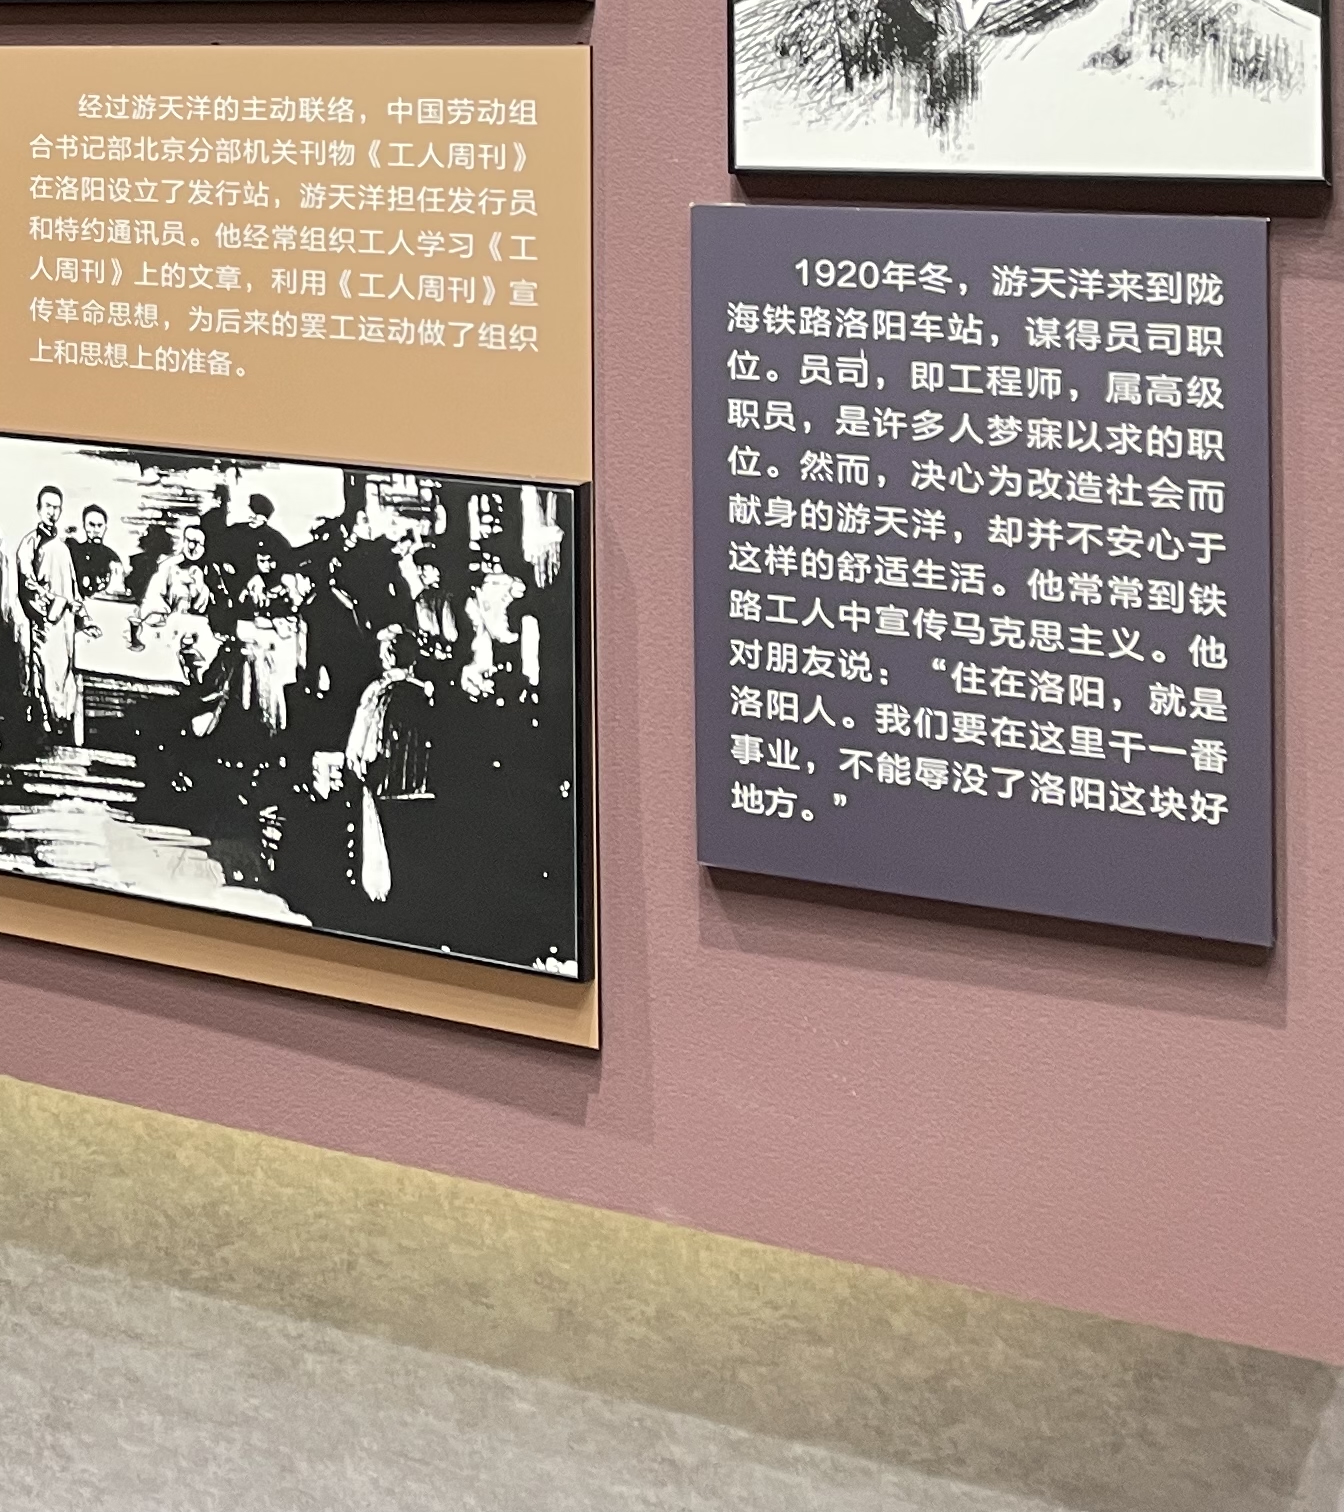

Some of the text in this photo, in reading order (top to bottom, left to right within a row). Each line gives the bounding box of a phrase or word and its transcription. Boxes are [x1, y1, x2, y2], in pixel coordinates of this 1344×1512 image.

[78, 94, 538, 126] 经过游天洋的主动联络，中国劳动组
[29, 134, 528, 172] 合书记部北京分部机关刊物《工人周刊》
[29, 175, 538, 217] 在洛阳设立了发行站，游天洋担任发行员
[29, 217, 538, 261] 和特约通讯员。他经常组织工人学习《工
[29, 257, 539, 307] 人周刊》上的文章，利用《工人周刊》宣
[793, 258, 1225, 307] 1920年冬，游天洋来到陇
[29, 297, 539, 352] 传革命思想，为后来的罢工运动做了组织
[726, 302, 1224, 358] 海铁路洛阳车站，谋得员司职
[29, 338, 247, 379] 上和思想上的准备。
[726, 351, 1224, 410] 位。员司，即工程师，属高级
[726, 399, 1225, 462] 职员，是许多人梦寐以求的职
[727, 447, 1225, 513] 位。然而，决心为改造社会而
[728, 494, 1226, 564] 献身的游天洋，却并不安心于
[728, 541, 1227, 618] 这样的舒适生活。他常常到铁
[728, 590, 1228, 669] 路工人中宣传马克思主义。他
[730, 687, 1228, 774] 洛阳人。我们要在这里干一番
[730, 735, 1229, 825] 事业，不能辱没了洛阳这块好
